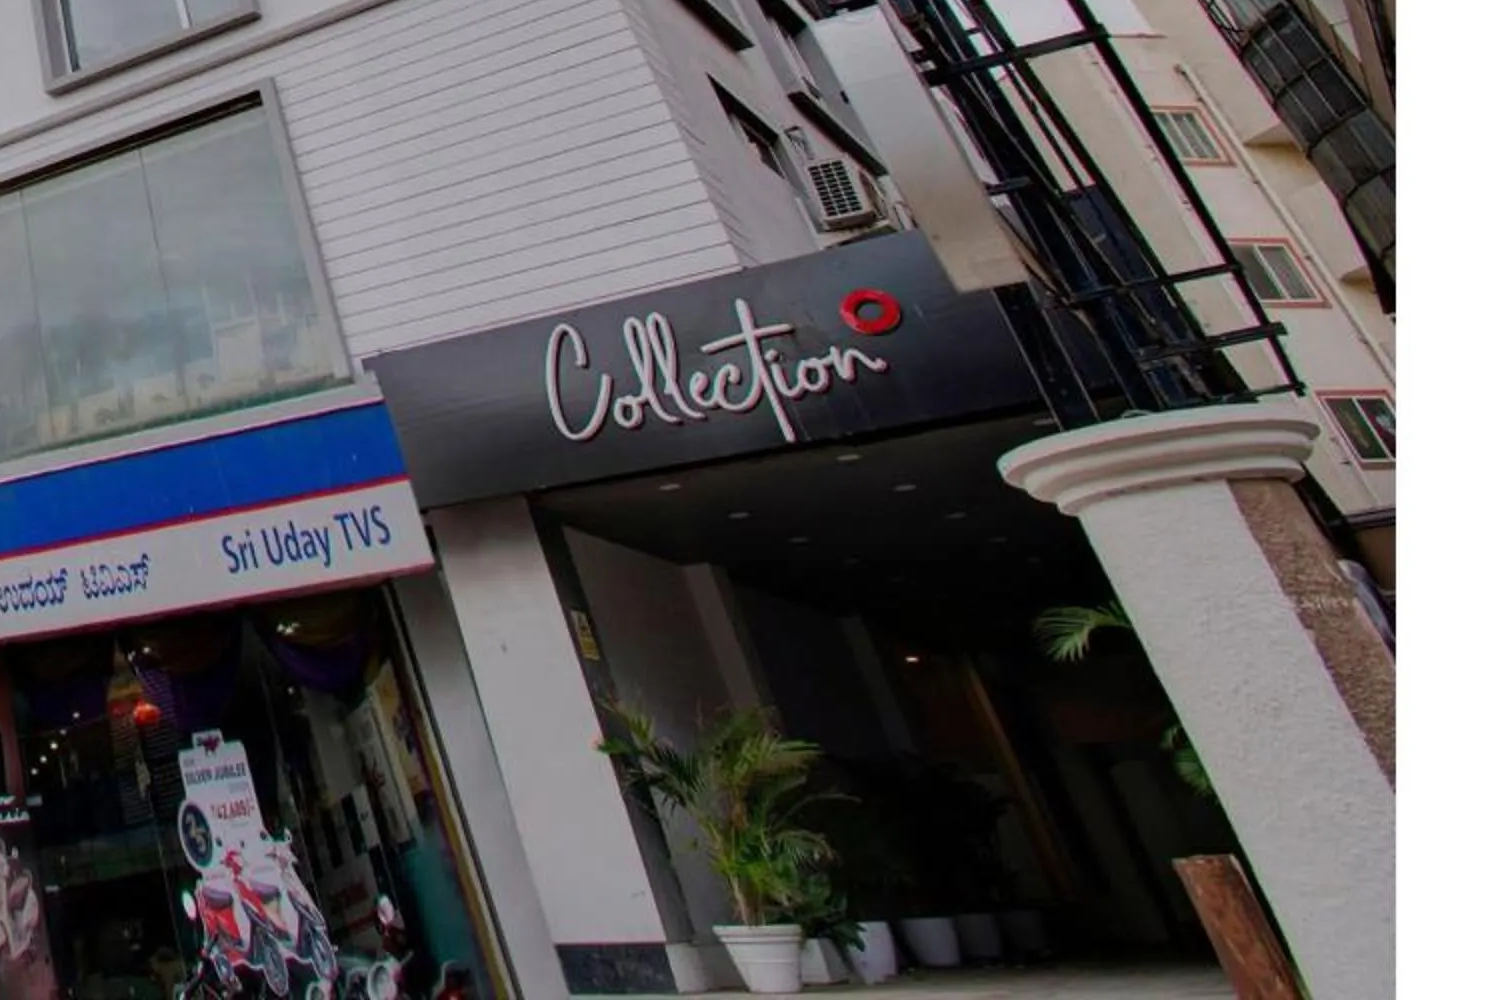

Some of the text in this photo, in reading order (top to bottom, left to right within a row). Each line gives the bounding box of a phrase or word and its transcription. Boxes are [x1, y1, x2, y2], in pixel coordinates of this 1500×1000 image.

[545, 299, 888, 443] Collection
[220, 504, 392, 575] Sri Uday TVS
